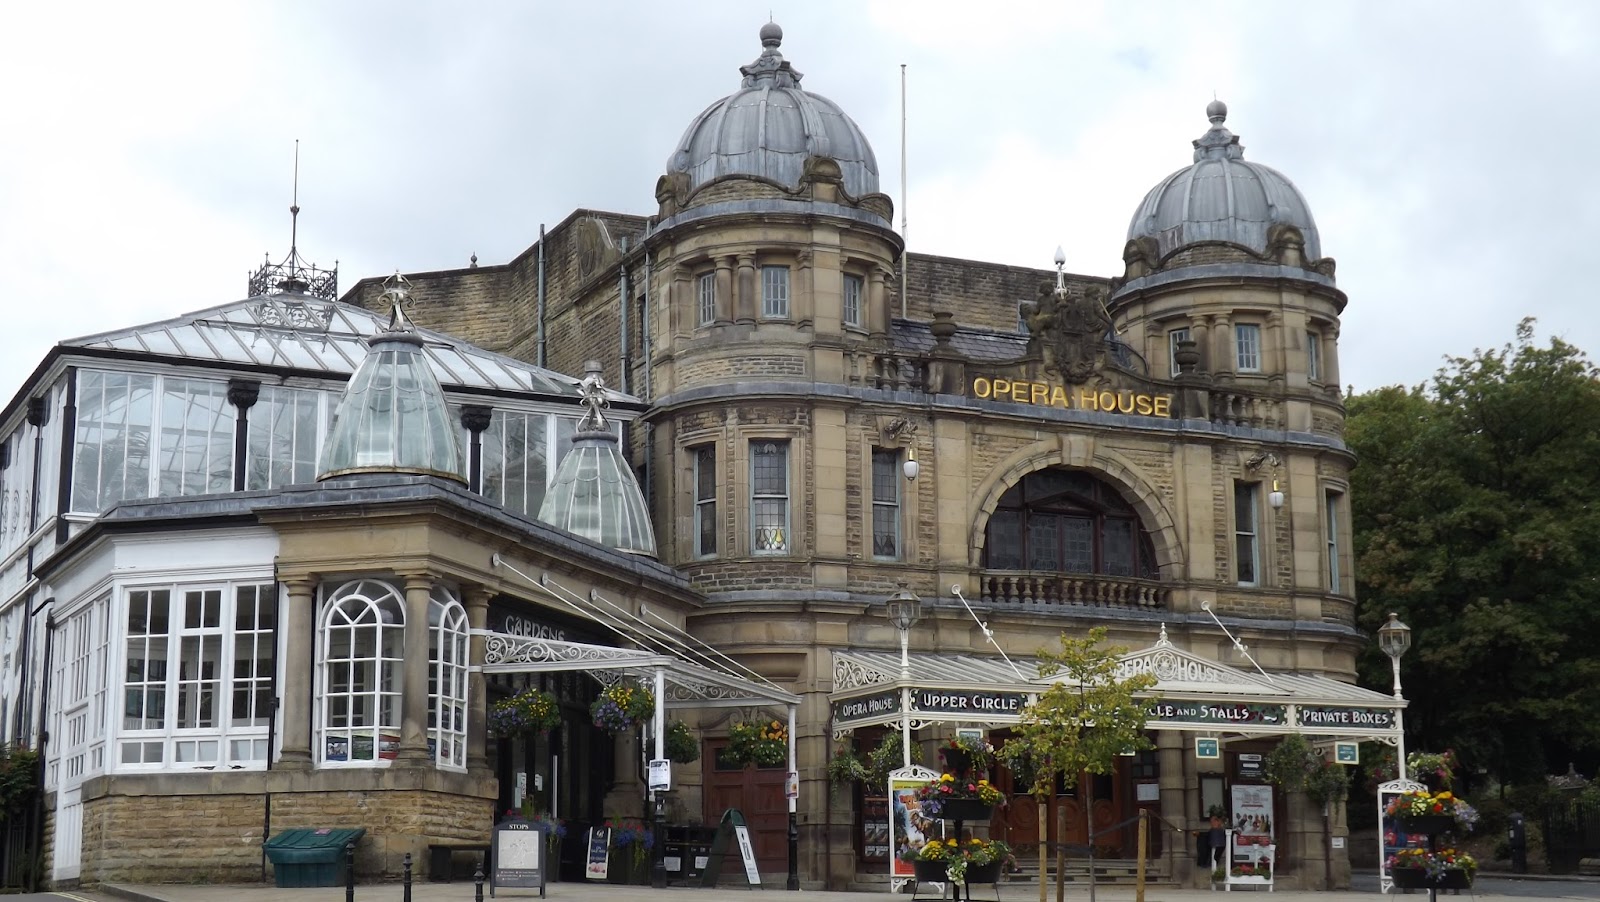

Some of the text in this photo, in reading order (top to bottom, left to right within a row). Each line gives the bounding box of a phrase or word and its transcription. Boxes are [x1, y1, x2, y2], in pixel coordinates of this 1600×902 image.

[973, 377, 1171, 417] OPERA HOUSE
[1177, 656, 1219, 682] HOUSE
[843, 698, 893, 717] OPERA HOUSE
[923, 693, 1018, 710] UPPER CIRCLE
[1200, 705, 1249, 720] STALLS
[1303, 709, 1389, 725] PRIVATE BOXES
